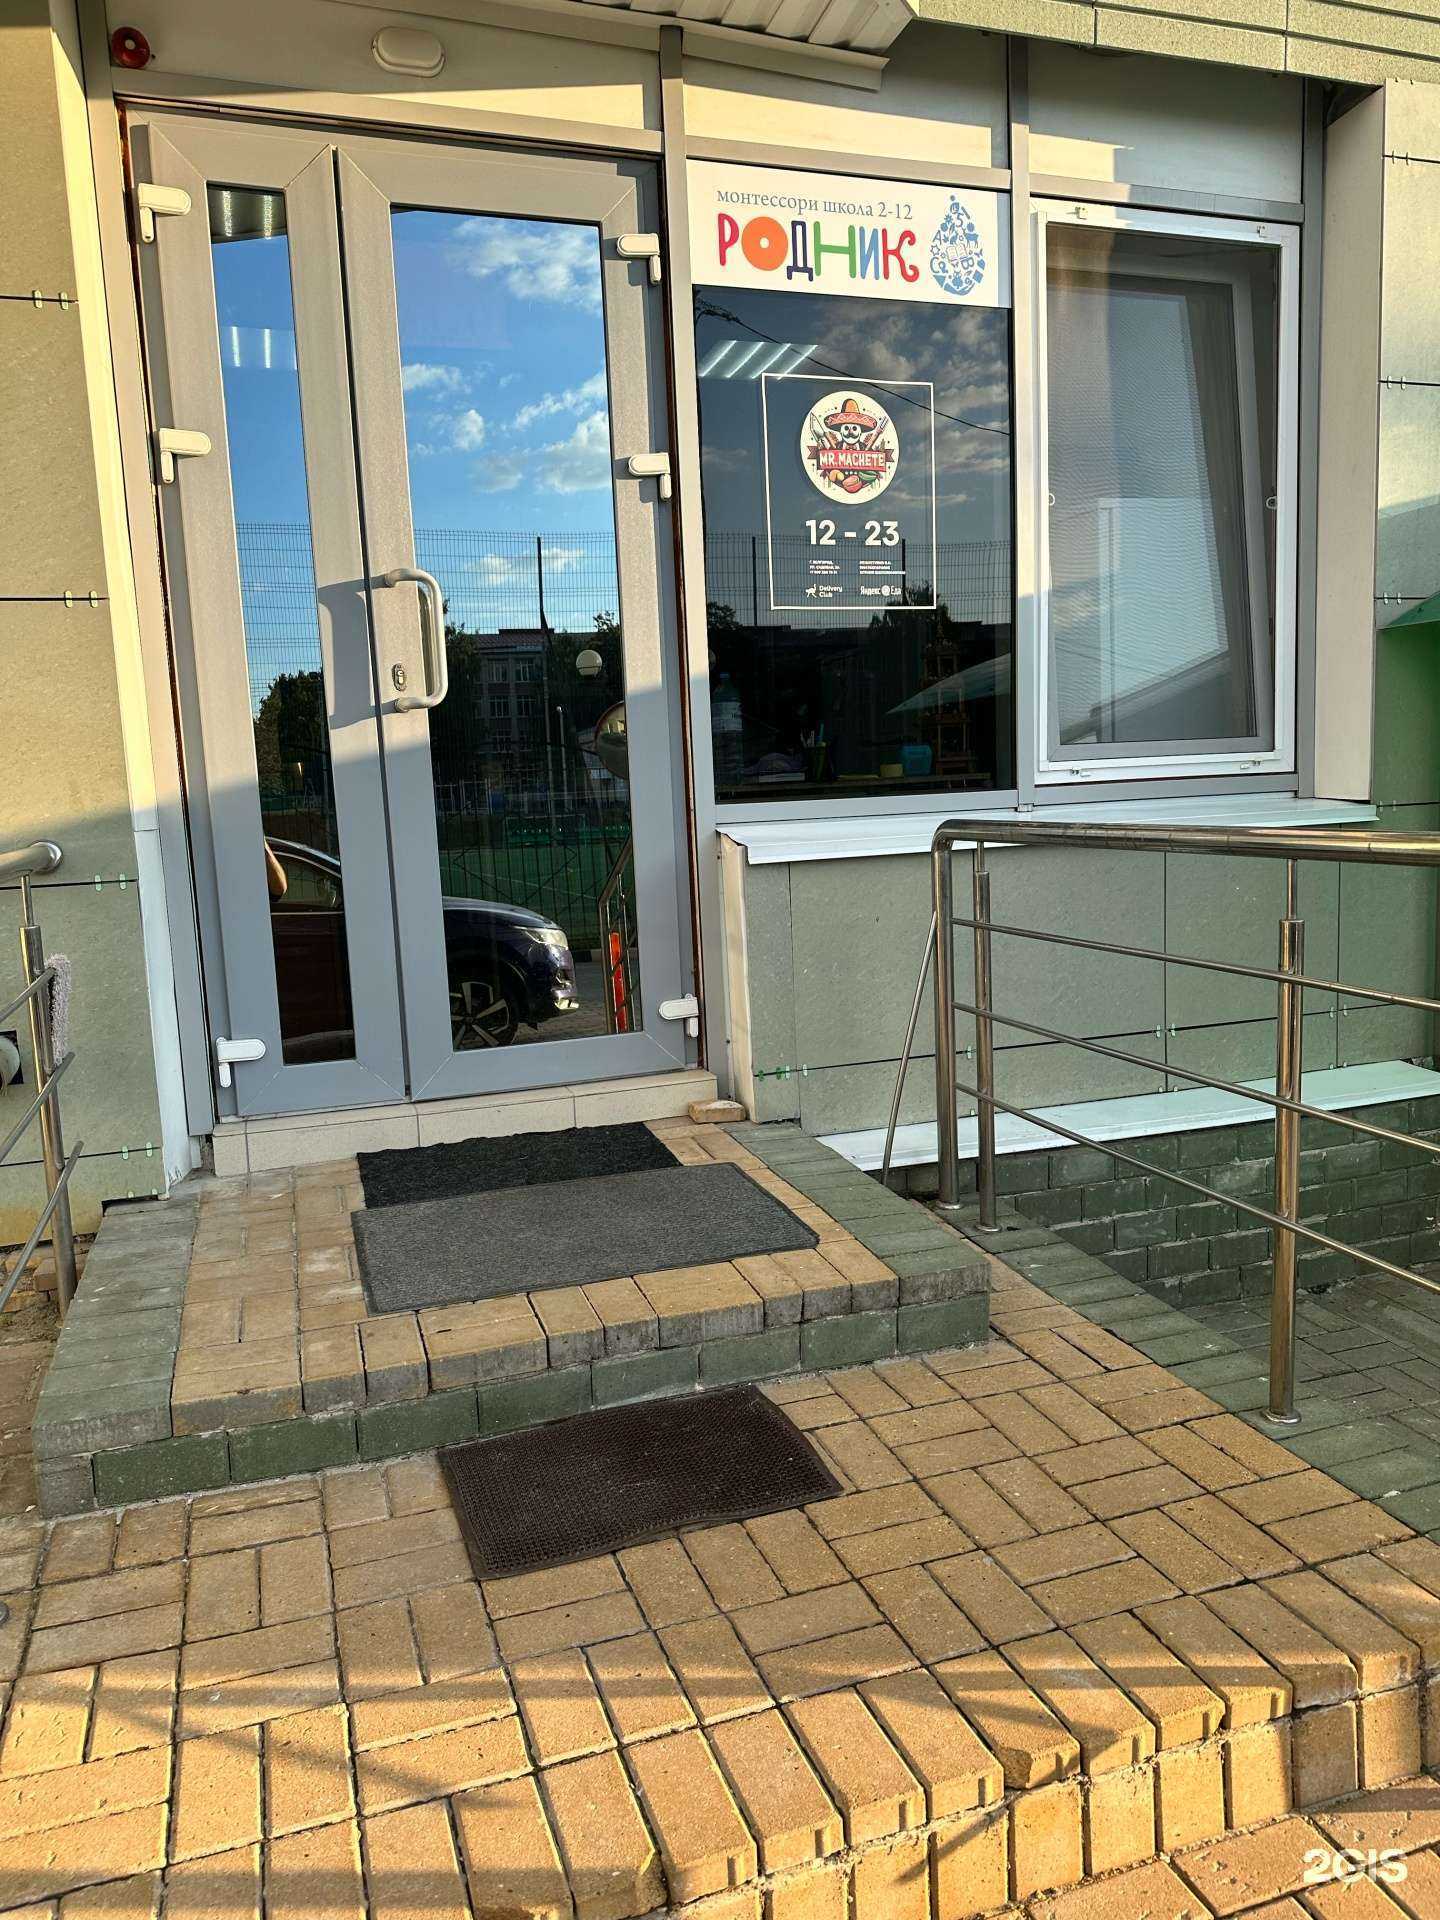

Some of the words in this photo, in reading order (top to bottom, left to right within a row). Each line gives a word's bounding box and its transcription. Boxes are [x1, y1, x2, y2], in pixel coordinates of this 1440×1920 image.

[717, 190, 818, 215] монтессори
[823, 201, 874, 217] школа
[878, 202, 913, 220] 2-12
[717, 213, 920, 282] РОДНИК
[839, 453, 886, 467] MACHETE
[805, 520, 836, 545] 12
[864, 520, 900, 546] 23
[819, 585, 843, 593] Delivery
